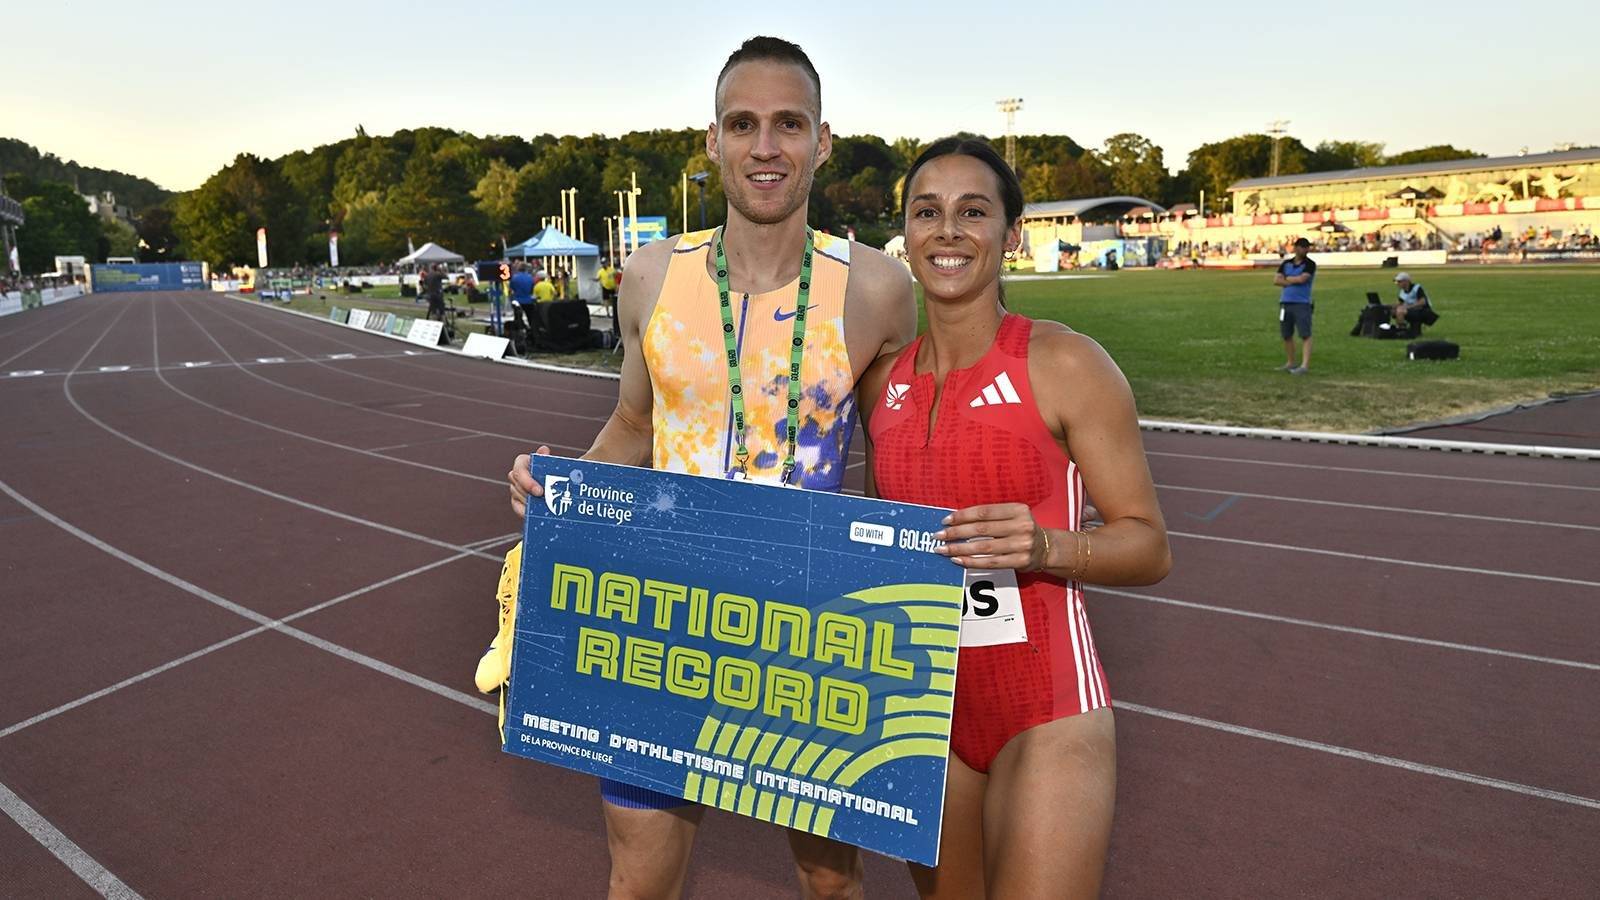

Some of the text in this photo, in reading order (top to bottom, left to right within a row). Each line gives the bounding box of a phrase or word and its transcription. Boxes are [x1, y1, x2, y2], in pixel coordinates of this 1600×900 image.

[499, 263, 510, 280] 3
[579, 483, 634, 504] Province
[577, 500, 632, 525] de Liège
[854, 526, 884, 540] GO WITH
[899, 528, 945, 554] GOLAZ
[550, 562, 915, 680] NATIONAL
[575, 626, 869, 736] RECORD
[520, 733, 613, 764] DE LA PROVINCE DE LIEGE
[522, 713, 919, 826] MEETING D'ATHLETISME INTERNATIONAL
